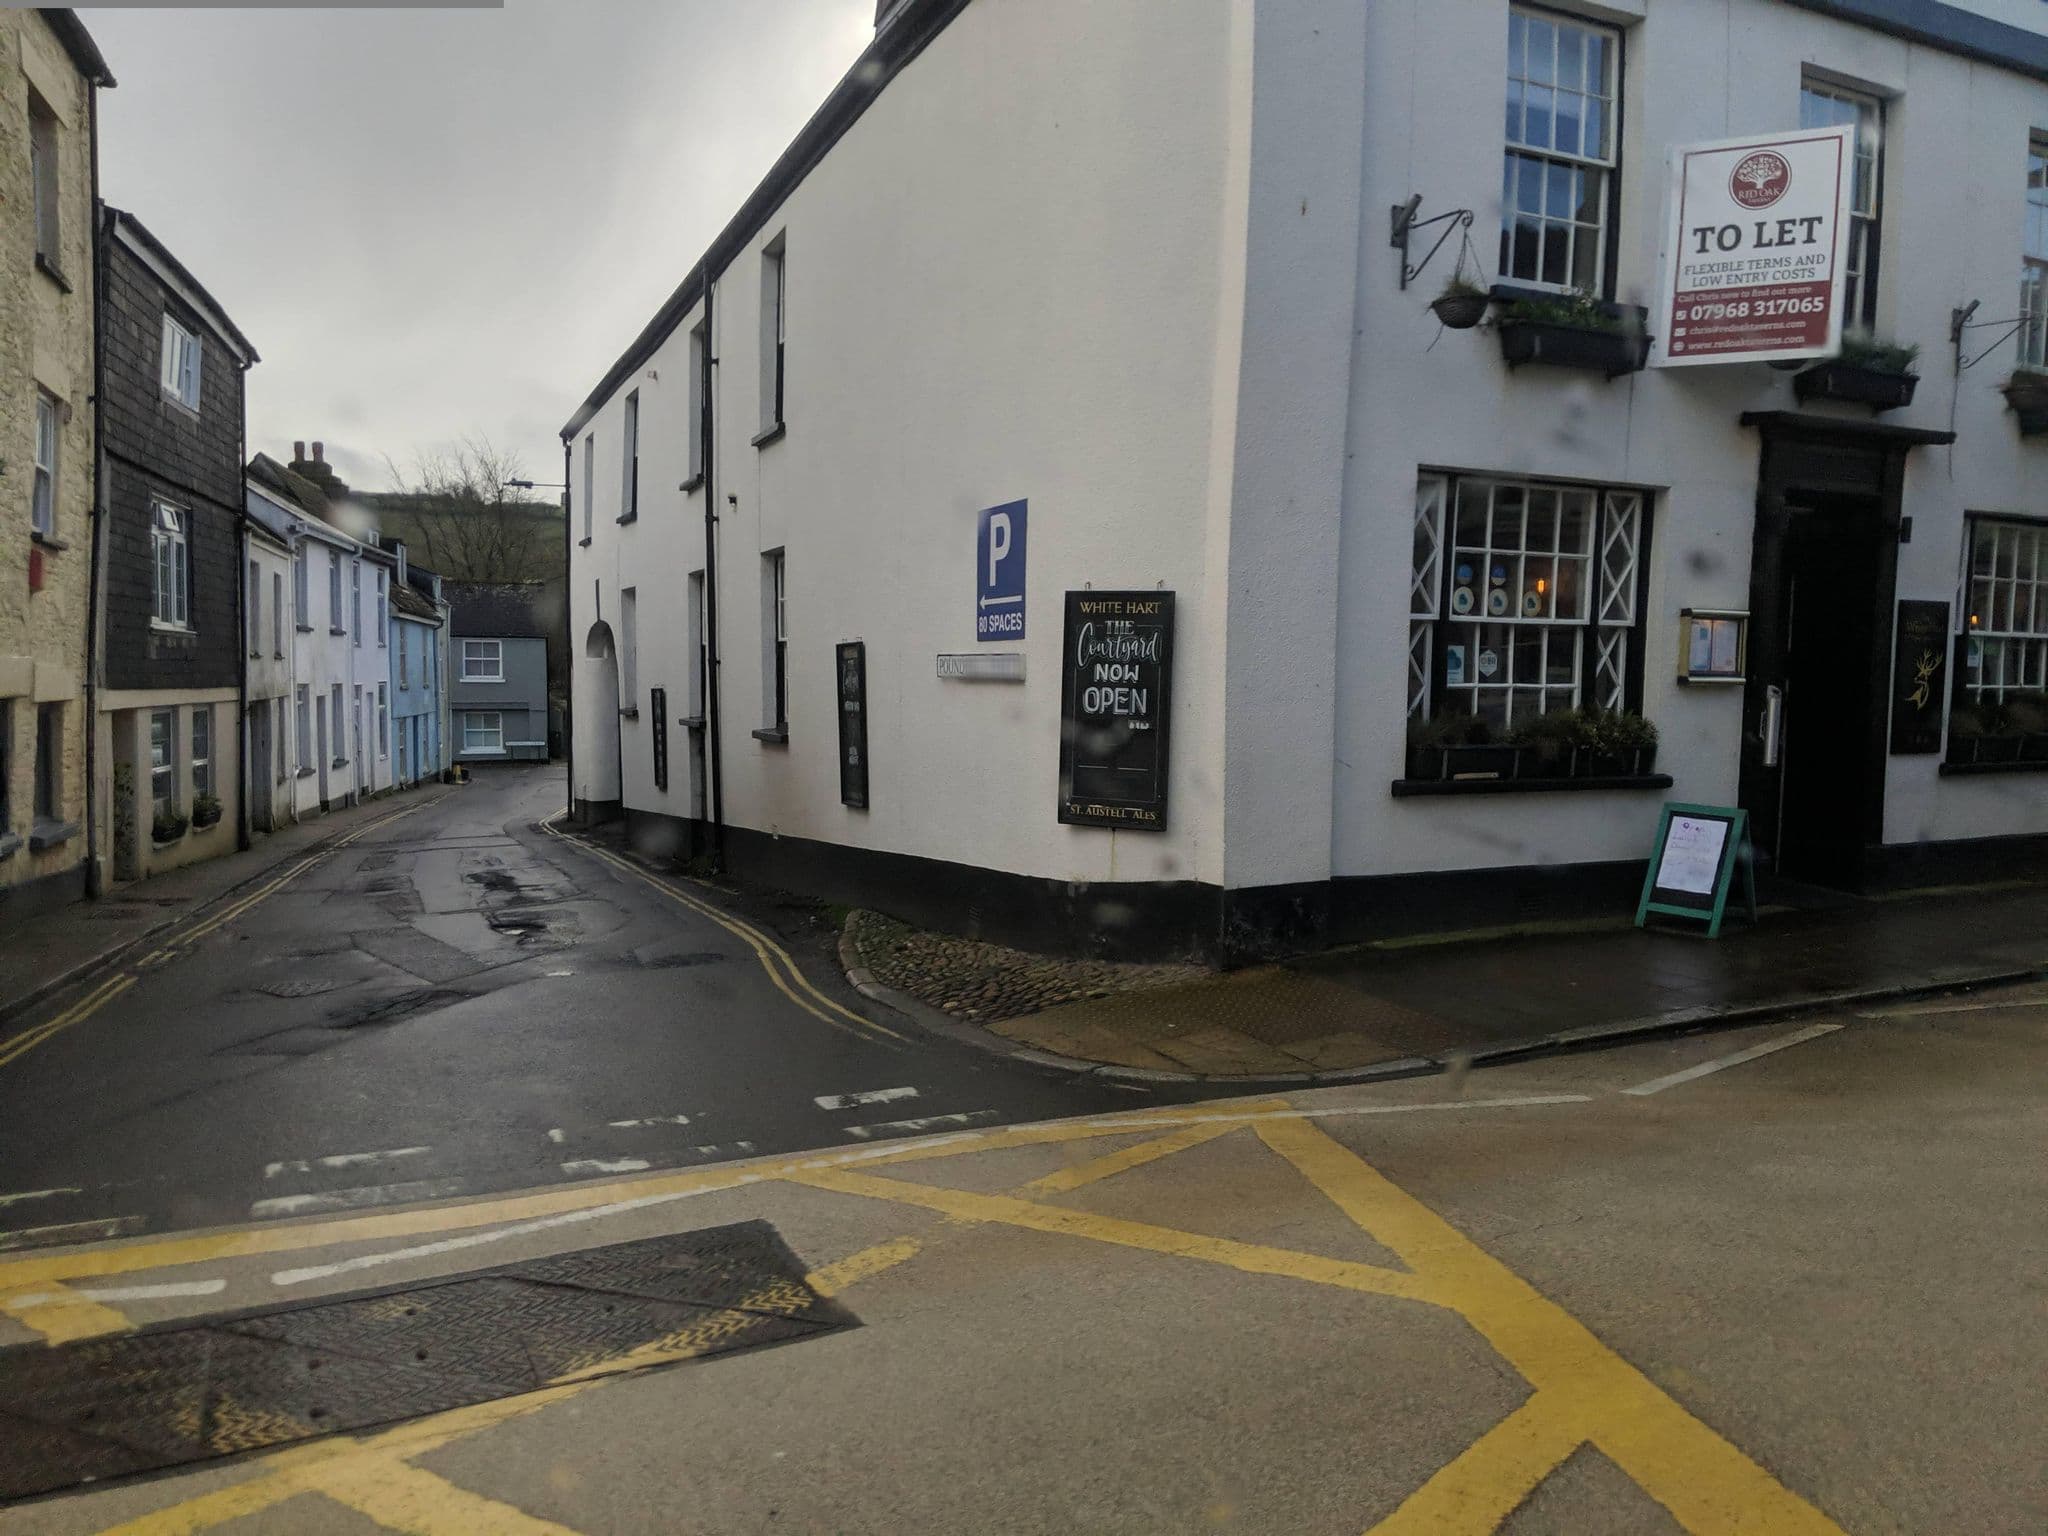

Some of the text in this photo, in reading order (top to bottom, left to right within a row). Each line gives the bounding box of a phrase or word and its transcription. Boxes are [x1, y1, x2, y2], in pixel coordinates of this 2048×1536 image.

[1692, 216, 1824, 254] TO LET
[1684, 253, 1826, 276] FLEXIBLE TERMS AND
[1692, 267, 1816, 288] LOW ENTRY COSTS
[1751, 287, 1770, 297] find
[1771, 287, 1787, 296] out
[1690, 296, 1825, 321] 07968 317065
[989, 512, 1012, 587] P
[1080, 601, 1161, 615] WHITE HART
[979, 612, 1023, 633] 80 SPACES
[1105, 620, 1135, 635] THE
[1077, 622, 1158, 667] Courtyard
[1094, 663, 1140, 683] NOW
[1083, 686, 1148, 715] OPEN
[1085, 806, 1128, 818] AUSTELL
[1132, 810, 1156, 821] ALES
